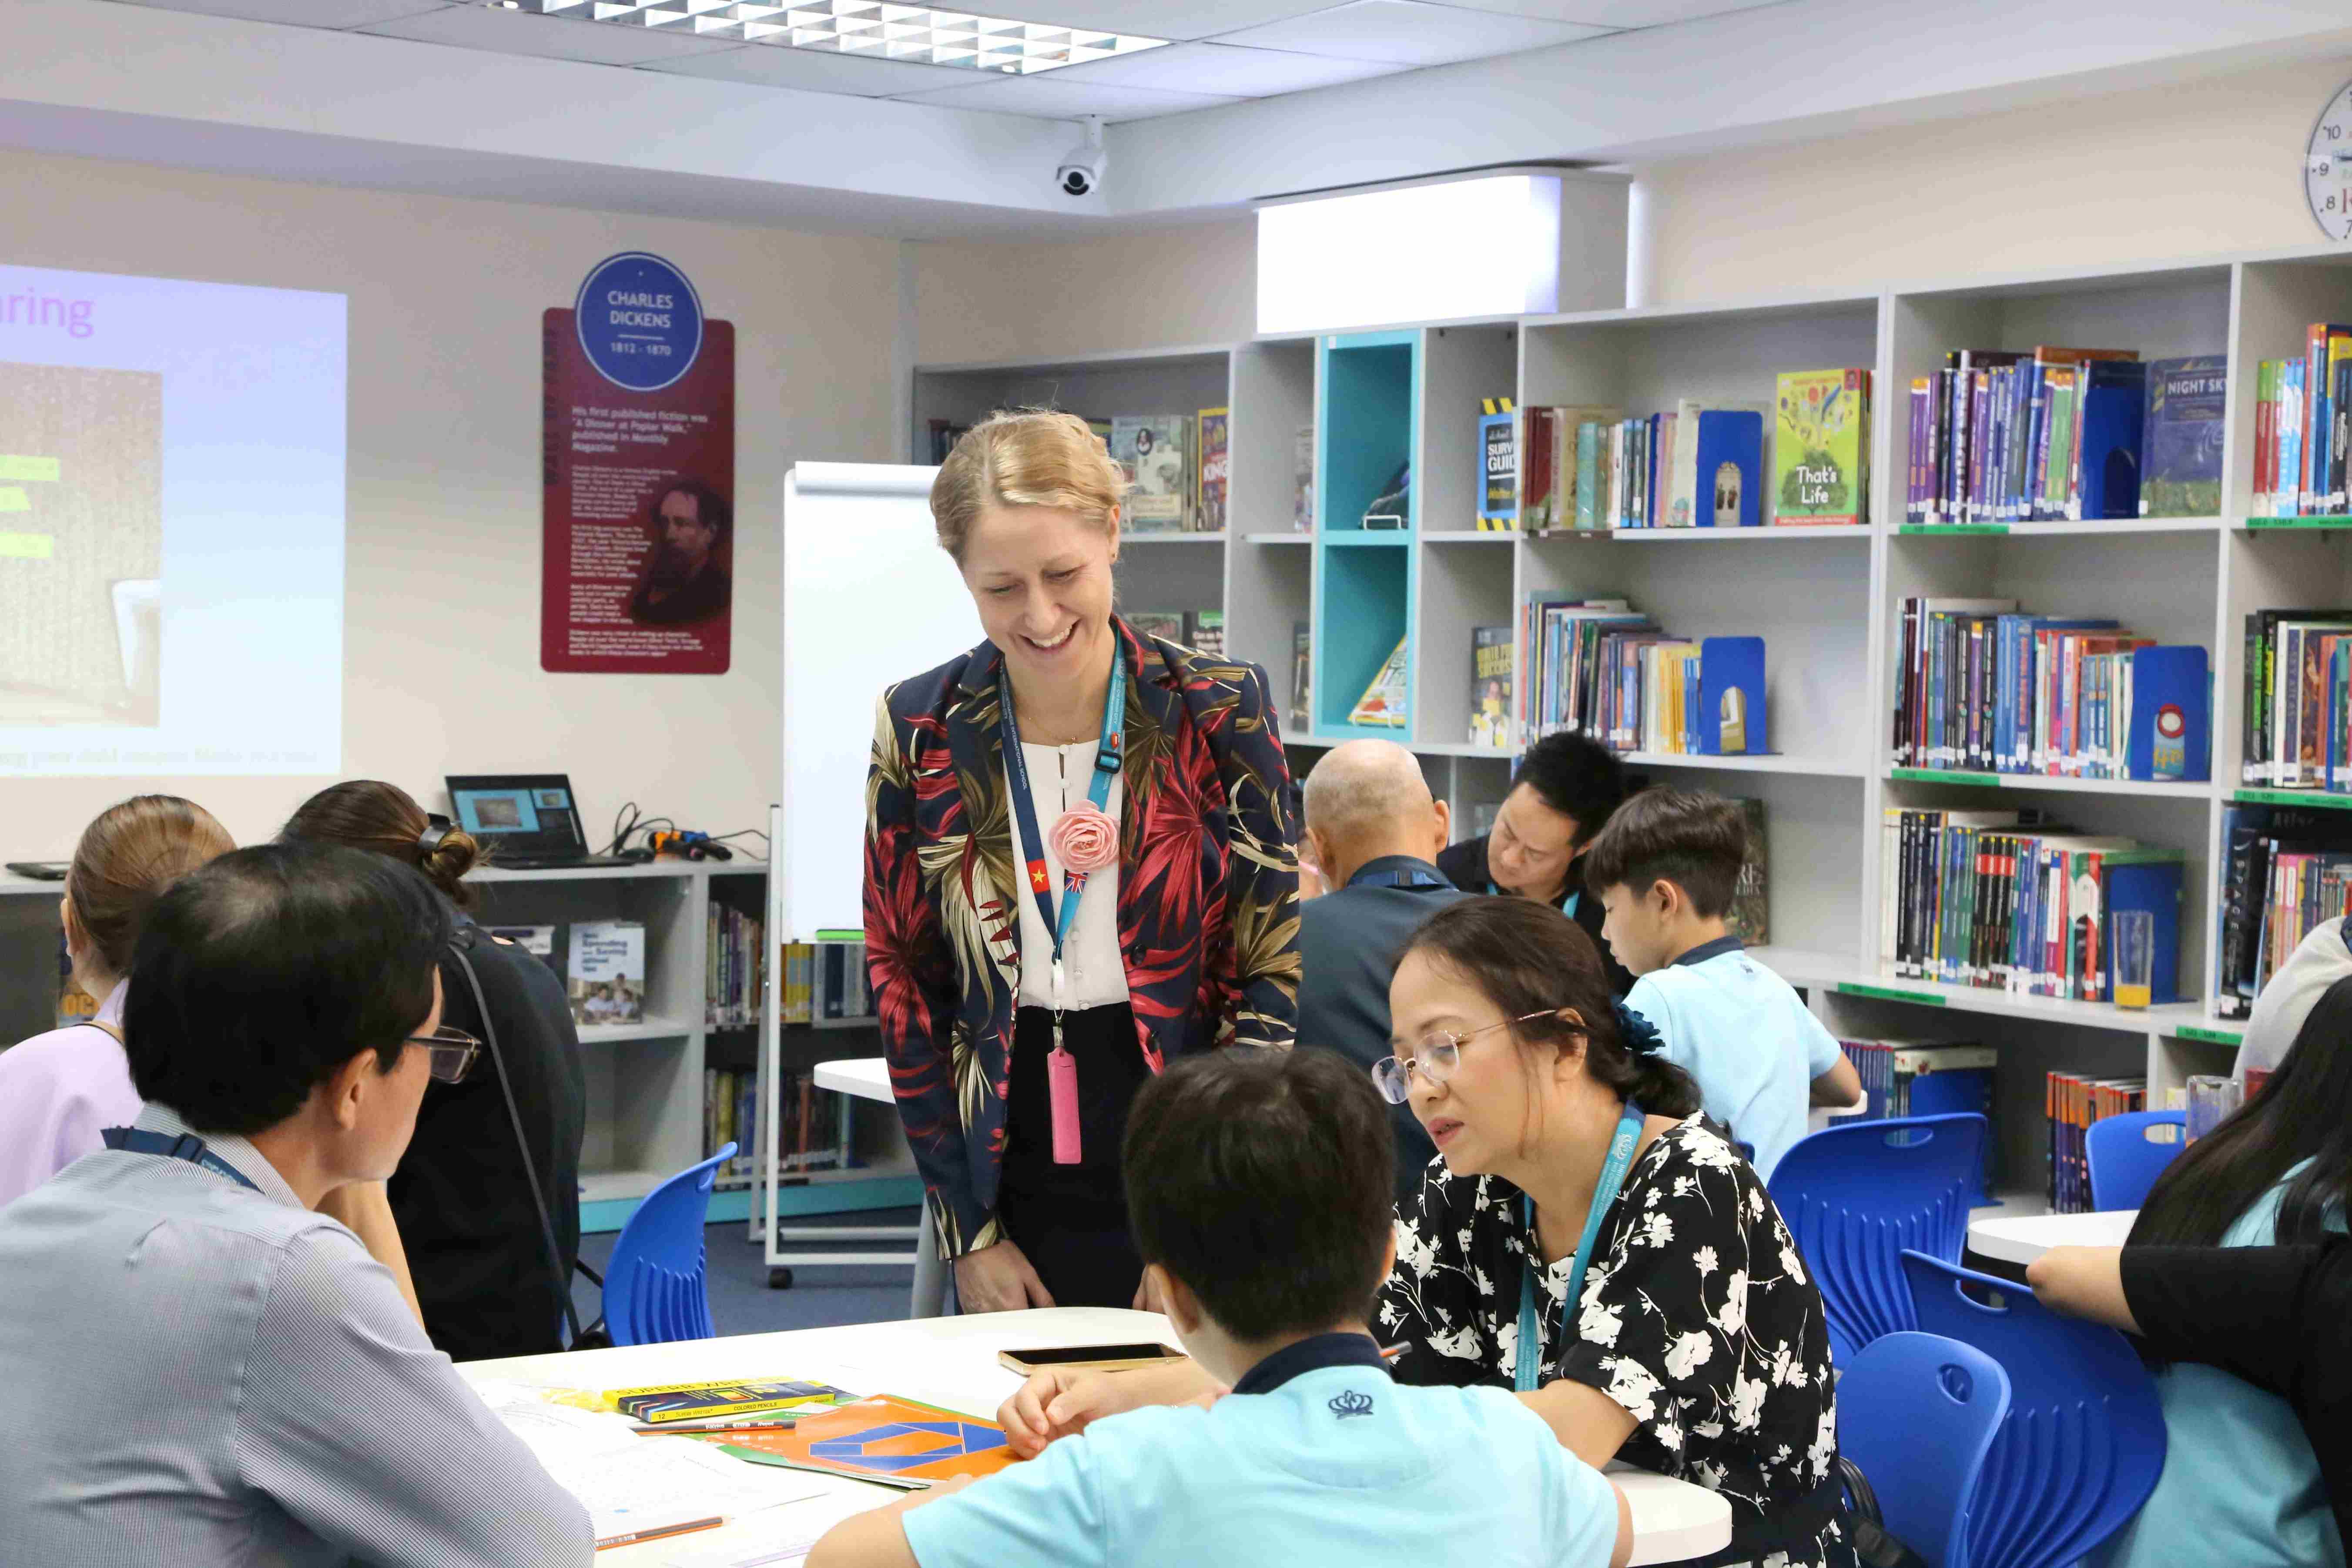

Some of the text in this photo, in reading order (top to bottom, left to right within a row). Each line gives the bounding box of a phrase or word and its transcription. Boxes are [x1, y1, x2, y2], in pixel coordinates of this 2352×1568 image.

[2327, 125, 2341, 140] 10
[2319, 163, 2329, 176] 9
[2325, 196, 2335, 210] 8
[607, 290, 673, 309] CHARLES
[0, 286, 94, 339] ring
[610, 310, 671, 328] DICKENS
[610, 342, 636, 354] 1812
[646, 344, 672, 356] 1870
[2168, 377, 2227, 395] NIGHT SK
[1796, 465, 1837, 484] That's
[1801, 486, 1829, 505] Life
[1010, 726, 1022, 767] INTERNATIONAL
[1019, 767, 1028, 790] SCHOOL
